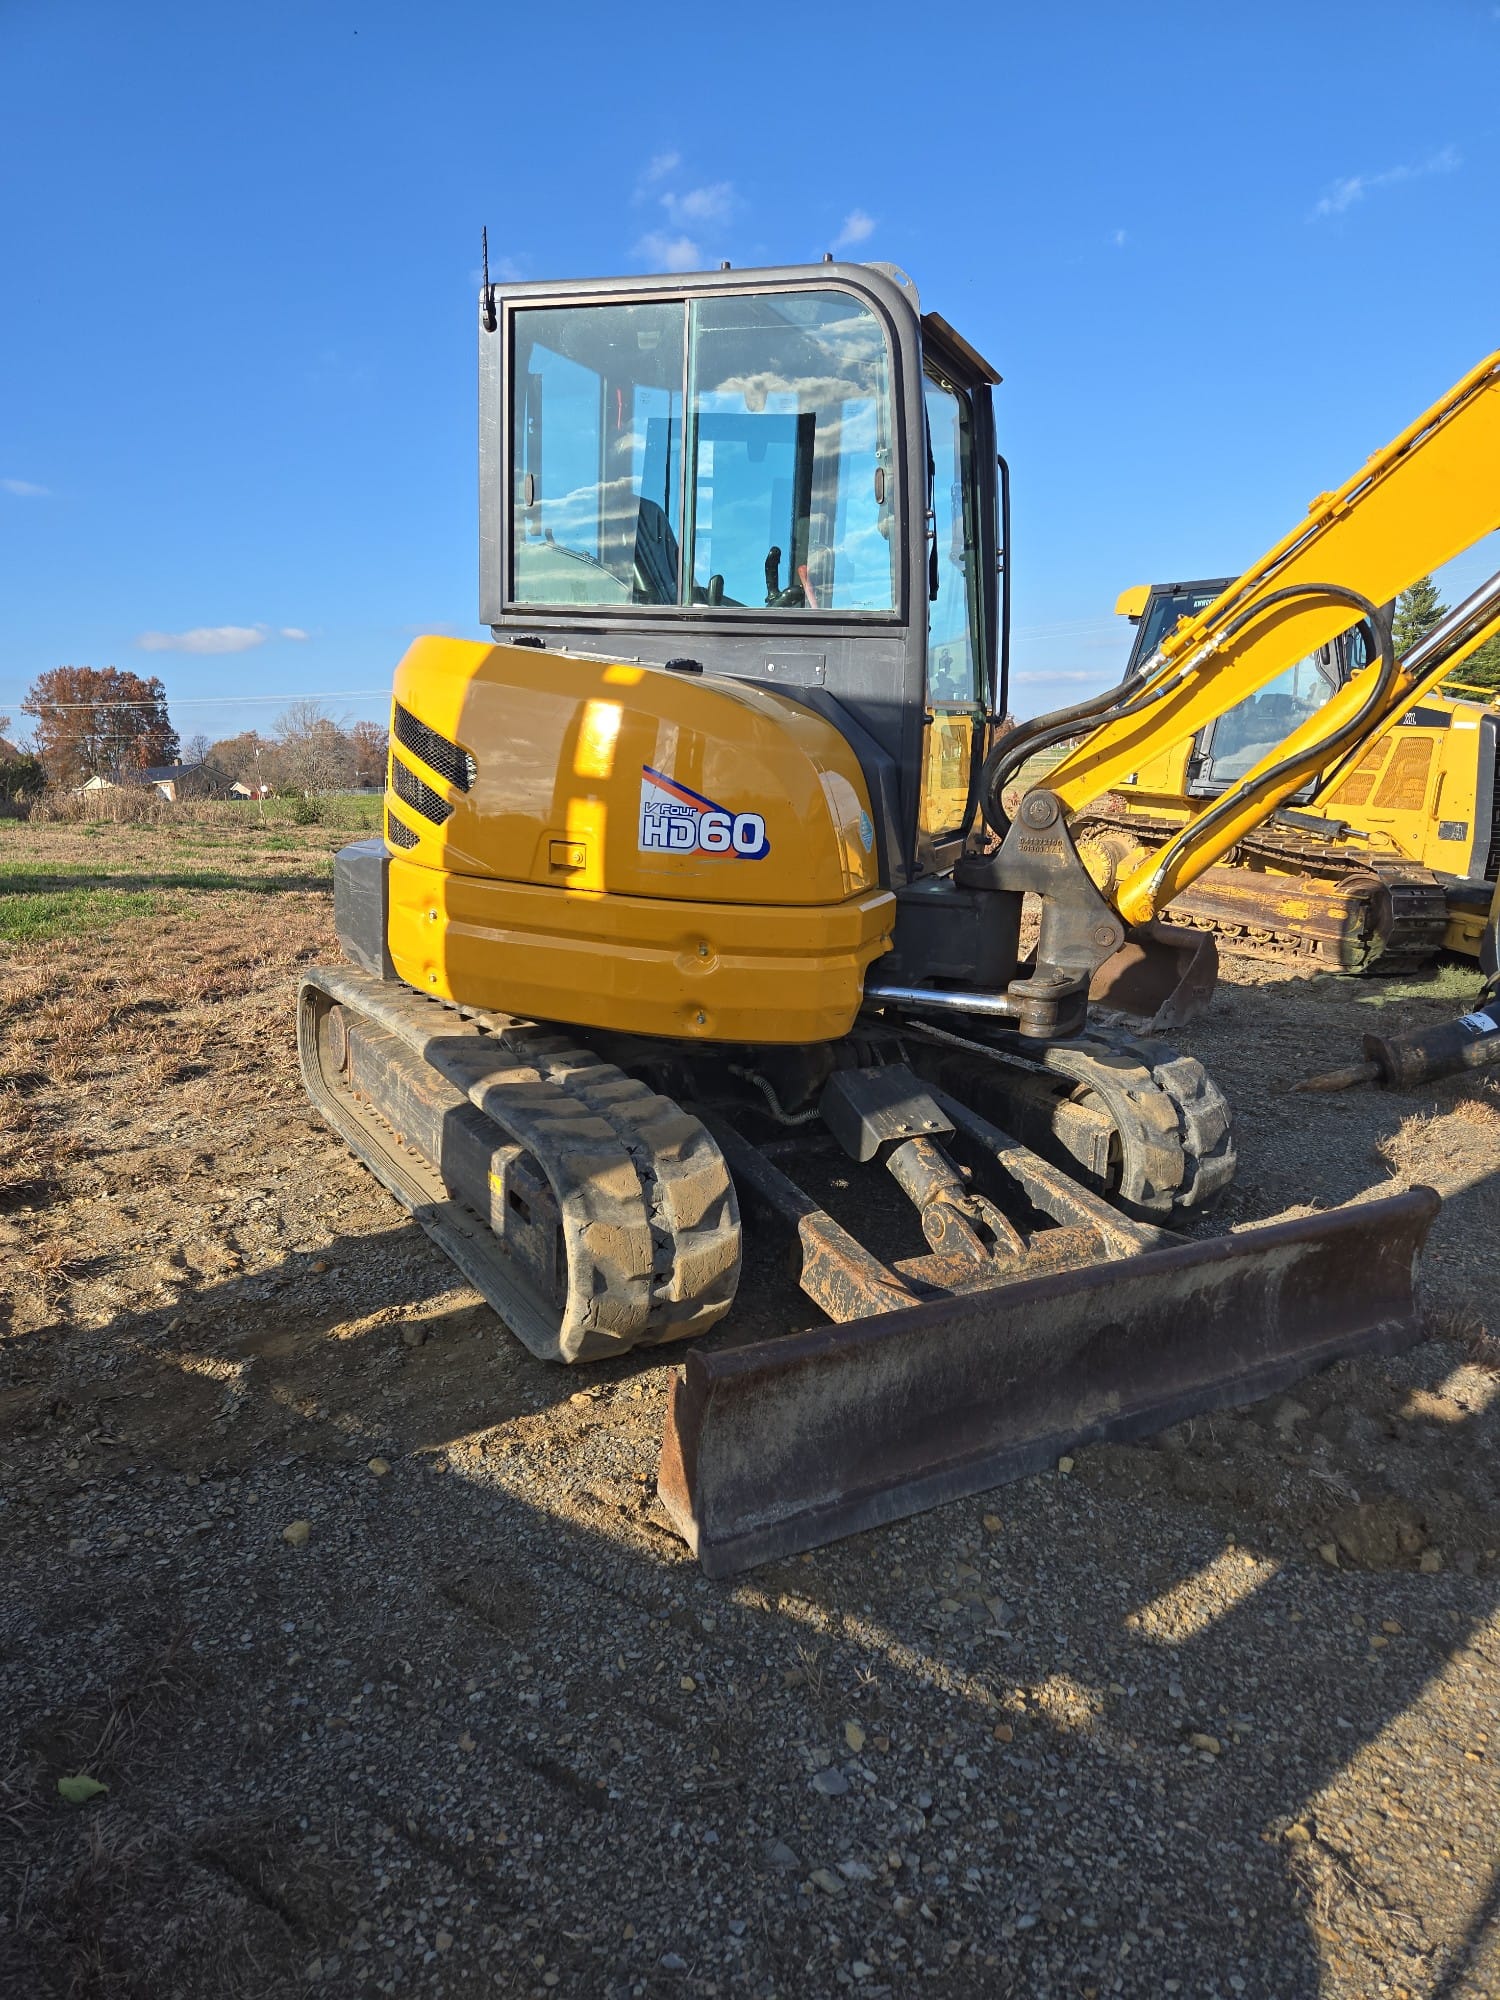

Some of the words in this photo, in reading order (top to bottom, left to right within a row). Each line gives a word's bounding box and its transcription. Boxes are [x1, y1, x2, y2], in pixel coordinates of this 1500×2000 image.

[645, 802, 659, 814] V
[660, 804, 698, 817] Four
[643, 811, 765, 854] HD60
